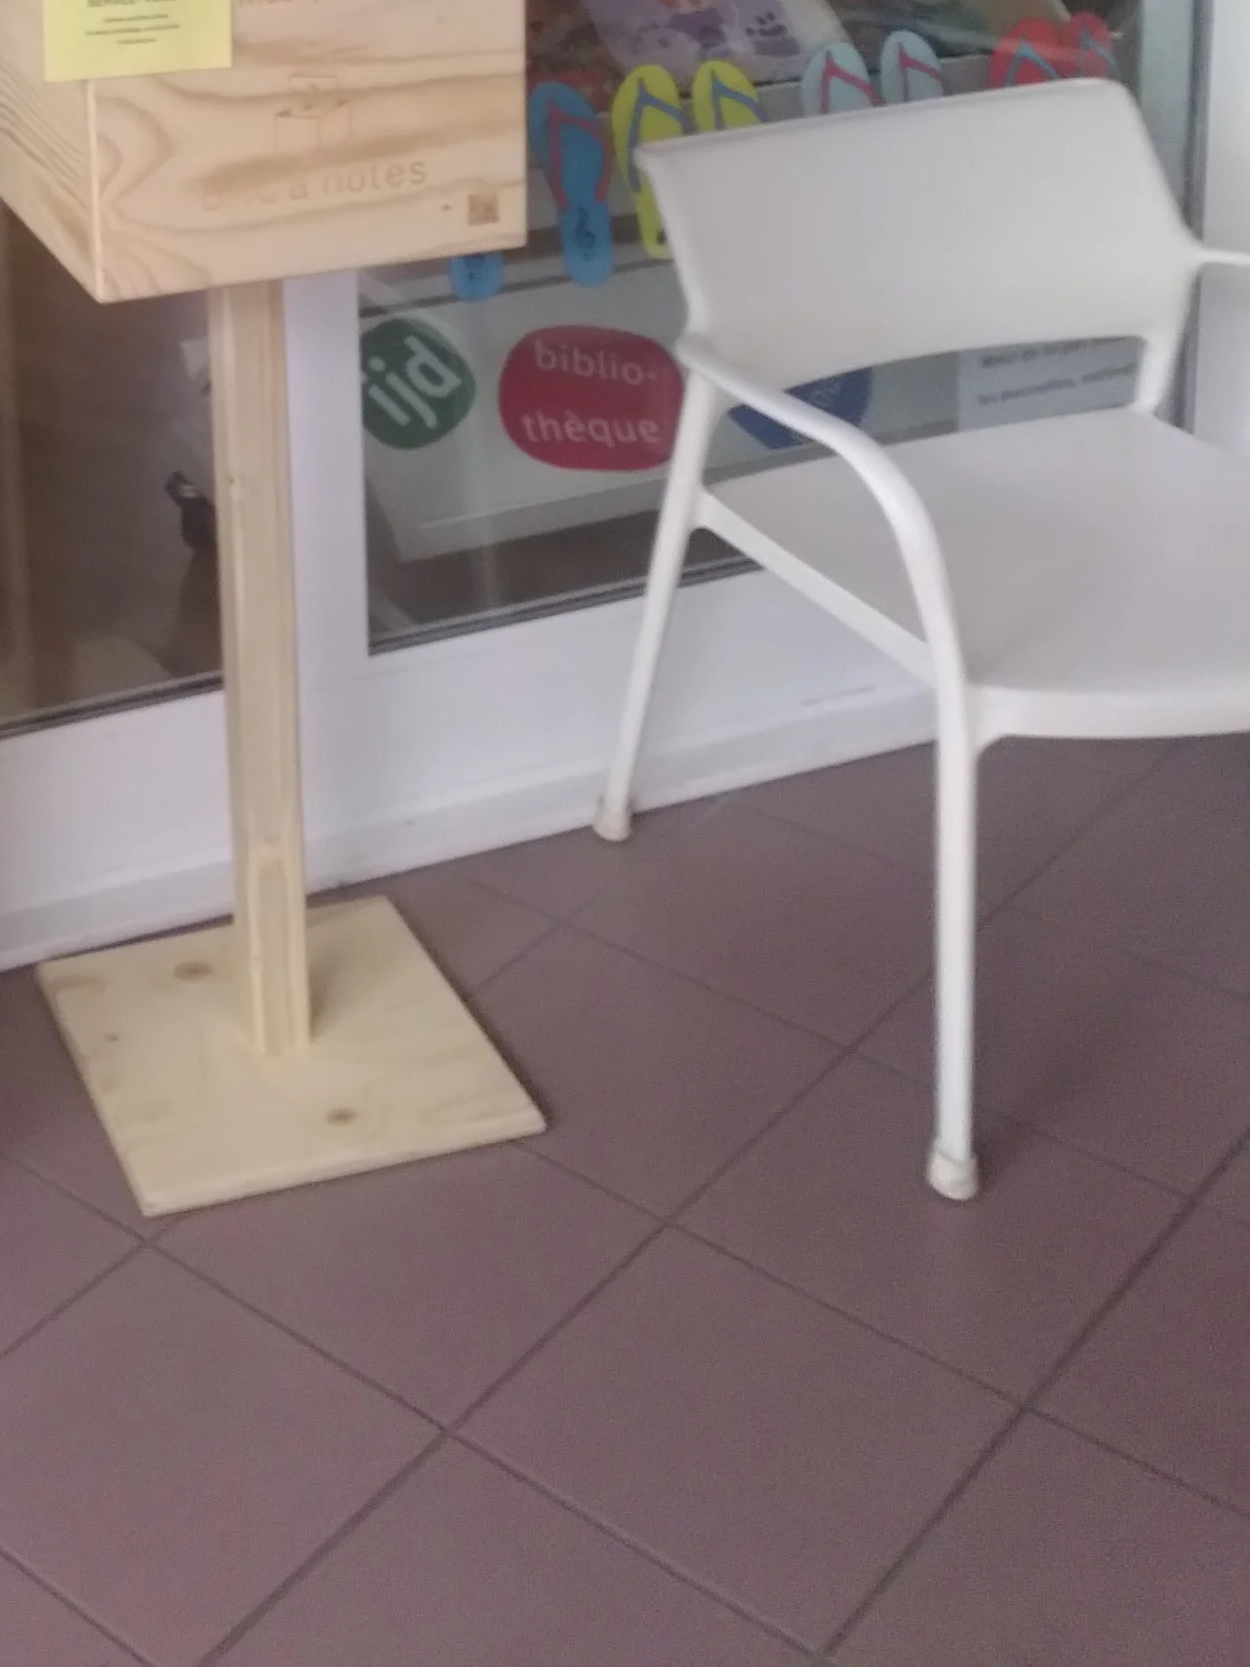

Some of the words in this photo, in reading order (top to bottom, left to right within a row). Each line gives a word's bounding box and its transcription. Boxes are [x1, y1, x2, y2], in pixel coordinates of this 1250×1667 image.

[323, 159, 428, 196] notes
[361, 335, 463, 430] ijd
[533, 339, 659, 387] biblio-
[521, 410, 662, 446] thèque
